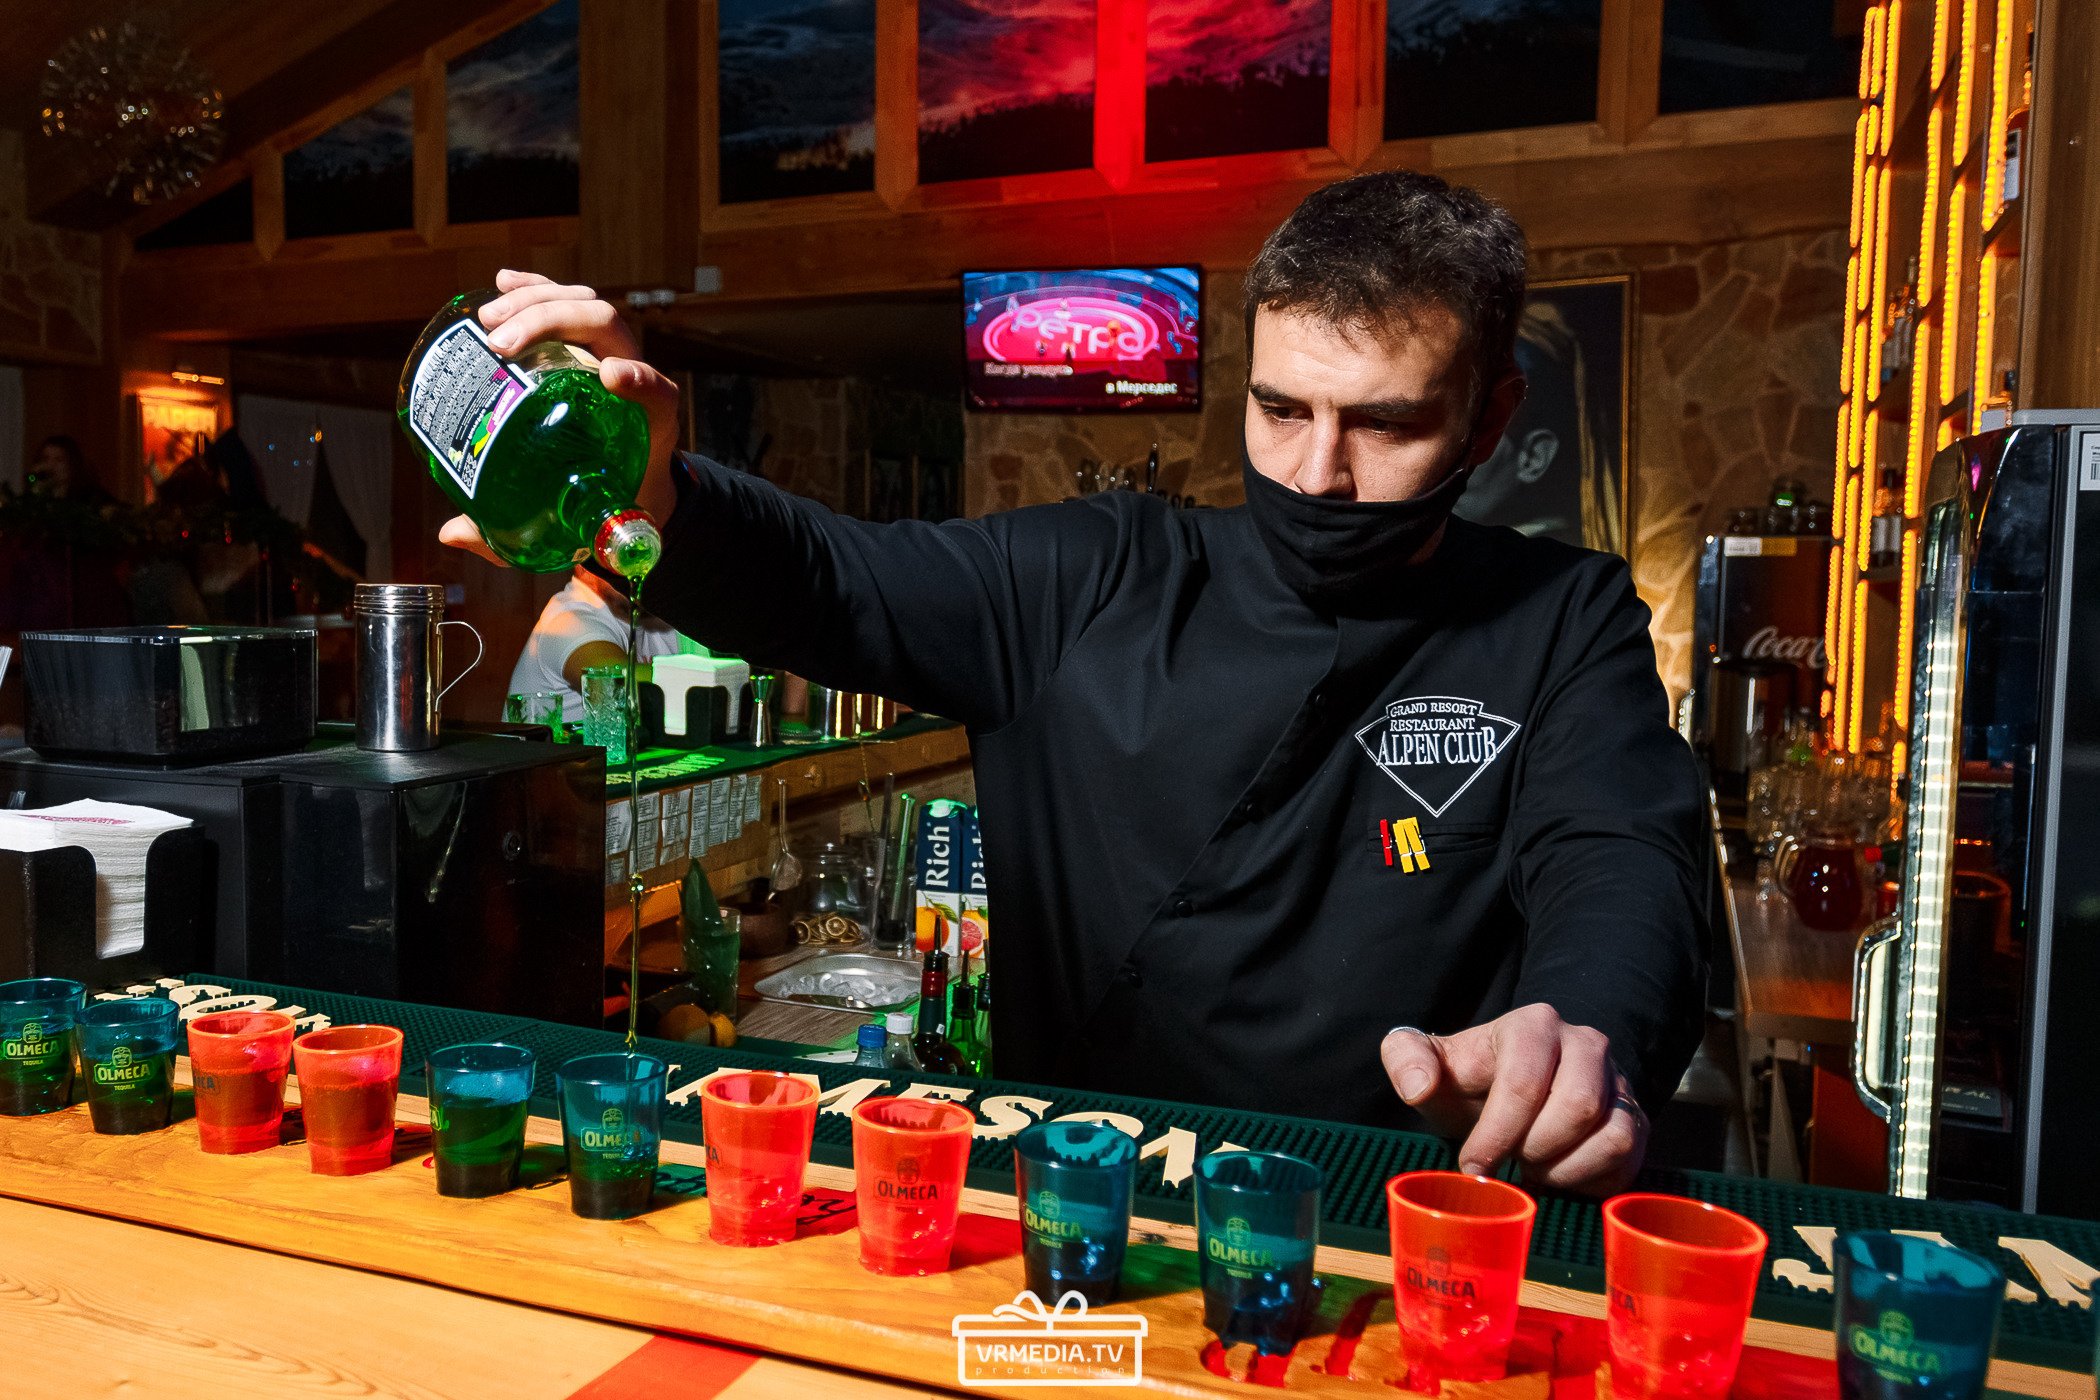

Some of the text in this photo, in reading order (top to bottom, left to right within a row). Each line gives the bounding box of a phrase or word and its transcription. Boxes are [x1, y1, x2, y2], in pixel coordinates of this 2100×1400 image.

[1105, 381, 1178, 396] в Мерседес
[1390, 702, 1477, 718] GRAND RESORT
[1390, 718, 1475, 732] RESTAURANT
[1376, 726, 1497, 766] ALPEN CLUB
[925, 826, 950, 887] Rich
[7, 1040, 58, 1056] OLMECA
[97, 1064, 151, 1081] OLMECA
[878, 1180, 938, 1200] OLMECA
[1025, 1208, 1083, 1238] OLMECA
[1209, 1237, 1275, 1267] OLMECA
[1407, 1266, 1476, 1299] OLMECA
